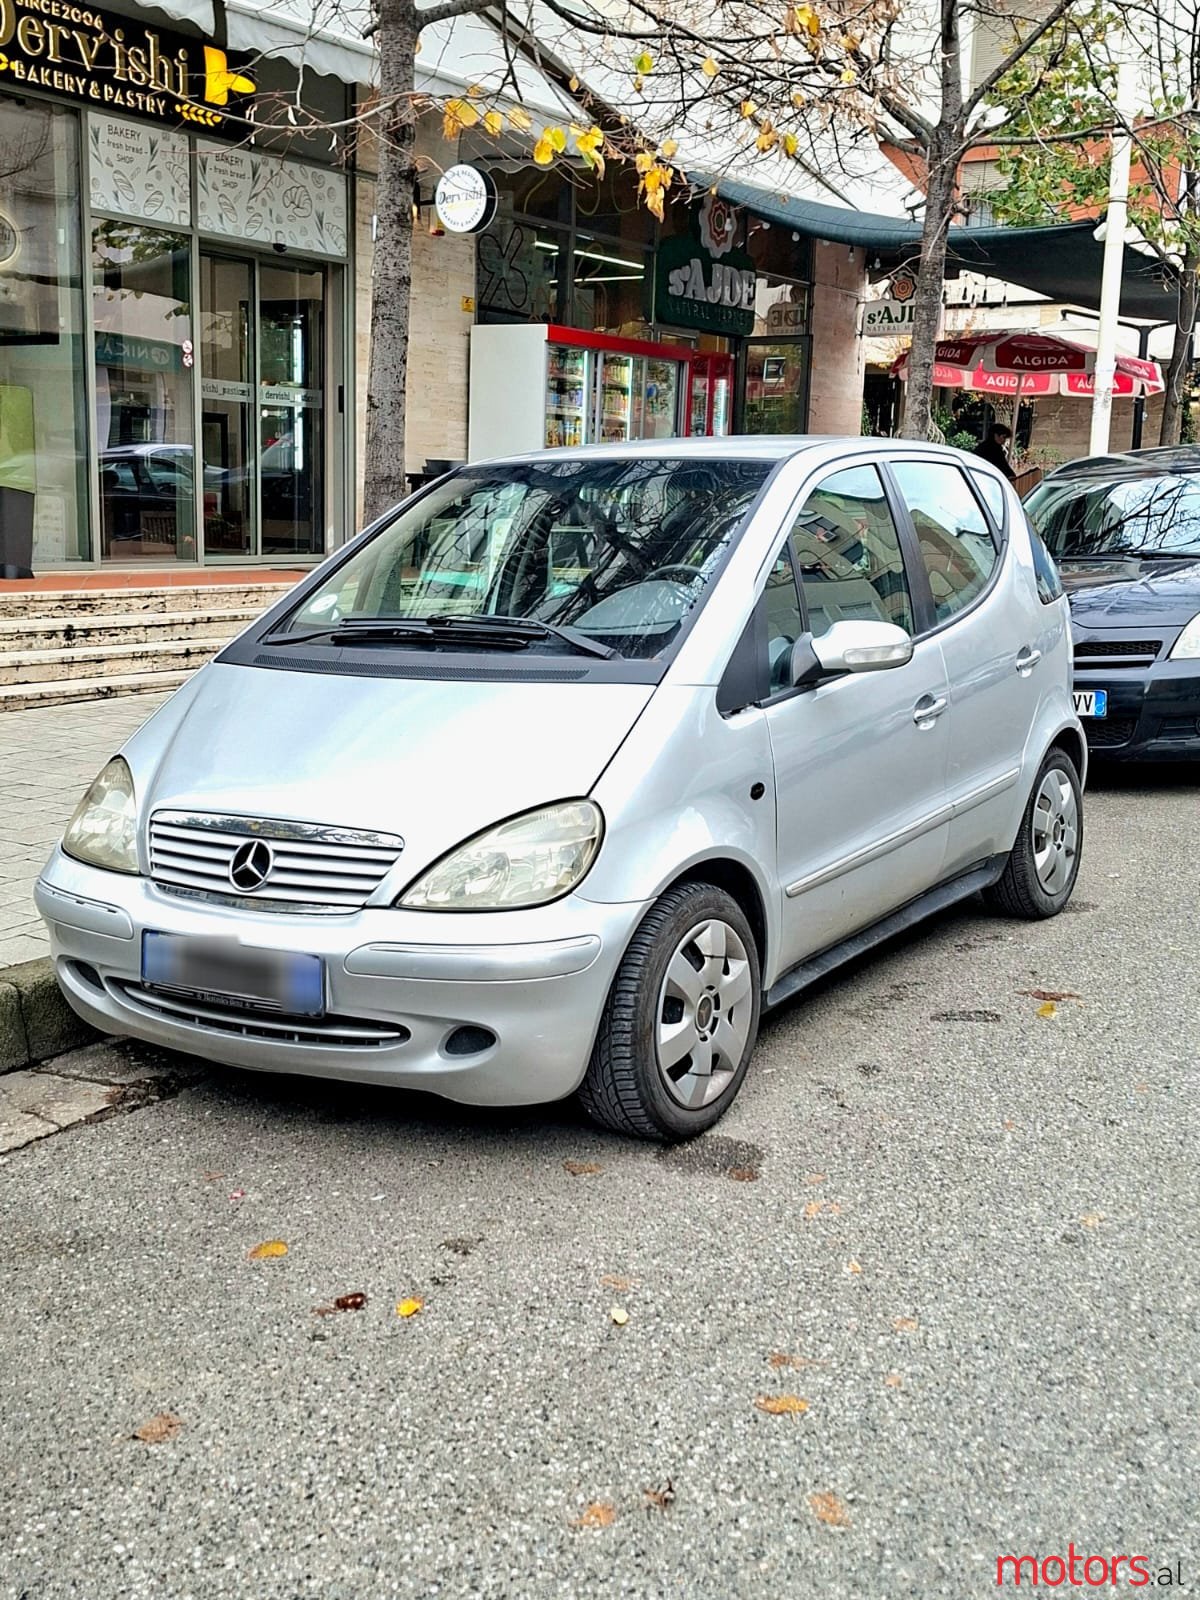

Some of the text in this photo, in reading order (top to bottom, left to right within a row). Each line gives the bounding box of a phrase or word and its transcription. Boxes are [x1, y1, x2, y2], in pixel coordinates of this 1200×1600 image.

[15, 60, 87, 95] BAKERY
[103, 84, 165, 116] PASTRY
[107, 124, 141, 141] BAKERY
[116, 153, 134, 164] SHOP
[1012, 355, 1069, 366] ALGIDA
